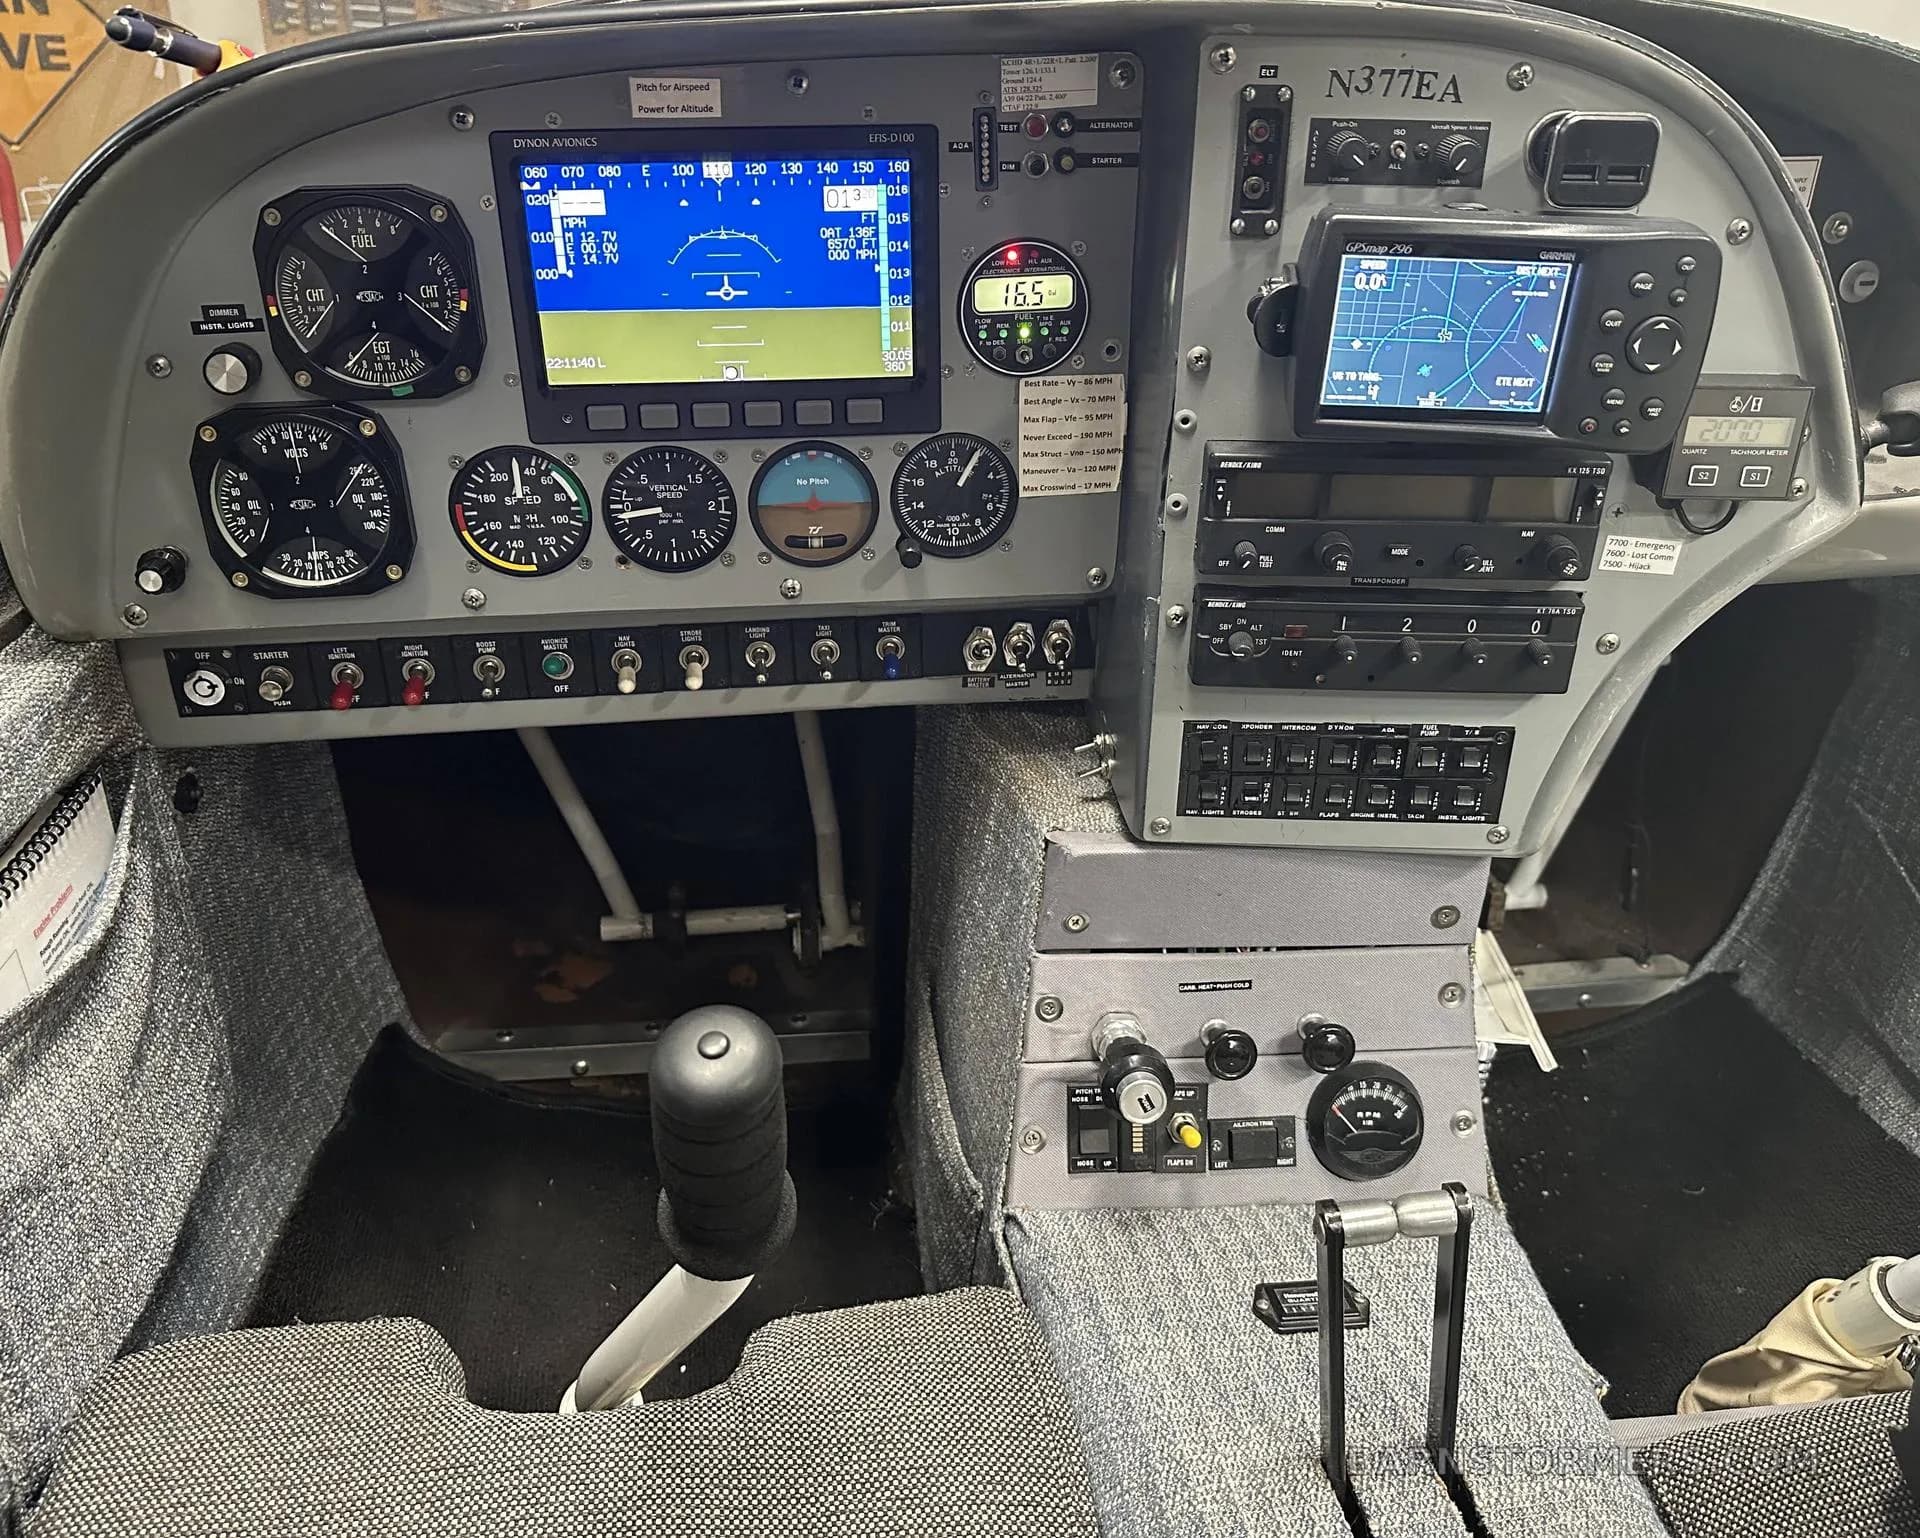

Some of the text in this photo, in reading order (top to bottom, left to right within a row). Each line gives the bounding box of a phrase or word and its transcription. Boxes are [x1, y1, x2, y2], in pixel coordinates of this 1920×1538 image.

[637, 82, 710, 93] Pitch for Airspeed
[1326, 65, 1463, 103] N377EA
[638, 104, 713, 114] Power for Altitude
[514, 137, 597, 148] DYNON AVIONICS
[869, 133, 915, 143] EFIS-D100
[525, 161, 909, 178] 060 070 080 100 120 130 140 150 160
[352, 235, 376, 248] FUEL
[1346, 243, 1576, 260] GPSmap 296 GARMIN
[307, 289, 324, 302] CHT
[421, 285, 438, 298] CHT
[1005, 281, 1044, 307] 16.5
[373, 342, 390, 354] EGT
[547, 358, 595, 368] 22:11:40
[1042, 397, 1062, 406] Angle
[1024, 416, 1038, 424] Max
[1041, 416, 1057, 424] Flap
[1064, 415, 1077, 423] Vfe
[1046, 433, 1072, 441] Exceed
[1095, 431, 1112, 439] MPH
[285, 448, 308, 458] VOLTS
[925, 460, 937, 468] 18
[1023, 467, 1057, 475] Maneuver
[1698, 471, 1760, 480] S2 S1
[490, 473, 508, 481] 200
[649, 484, 688, 492] VERTICAL
[353, 494, 365, 503] OIL
[478, 494, 496, 503] 180
[248, 501, 261, 509] OIL
[551, 515, 568, 524] 100
[484, 521, 501, 530] 160
[1609, 538, 1674, 551] 7700 Emergency
[308, 551, 329, 560] AMPS
[1606, 549, 1625, 557] 7600
[1650, 553, 1673, 561] Comm
[1629, 562, 1650, 570] Hijack
[195, 651, 288, 660] OFF STARTER
[554, 684, 569, 692] OFF
[49, 884, 73, 916] Problem
